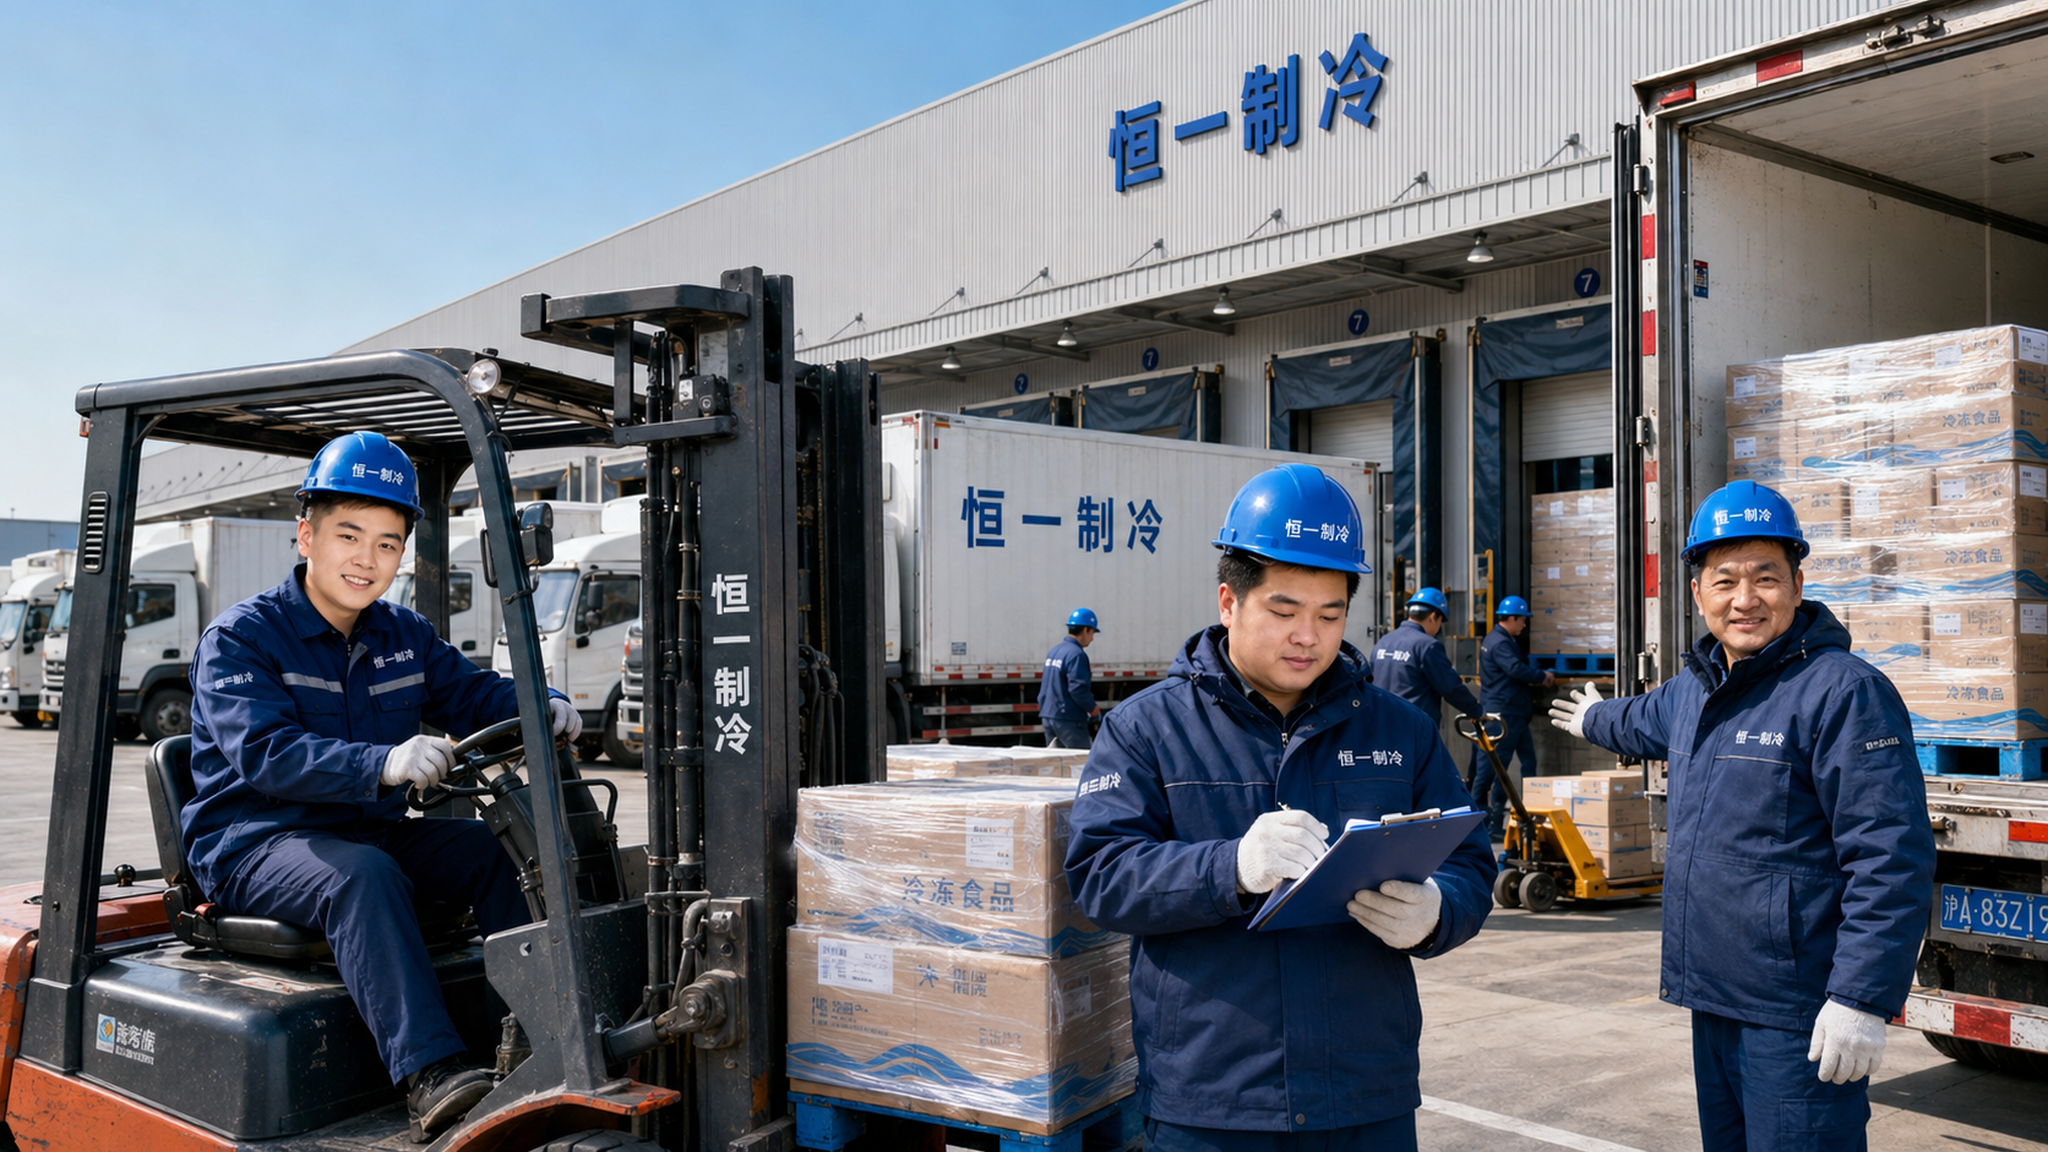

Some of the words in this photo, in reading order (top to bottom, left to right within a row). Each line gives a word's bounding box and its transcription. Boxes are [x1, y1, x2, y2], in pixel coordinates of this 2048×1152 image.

[1108, 32, 1389, 193] 恒一制冷
[1581, 273, 1593, 292] 7
[1353, 314, 1363, 331] 7
[352, 463, 404, 486] 恒一制冷
[961, 486, 1163, 555] 恒一制冷
[1714, 508, 1772, 526] 恒一制冷
[1285, 518, 1350, 543] 恒一制冷
[711, 573, 752, 755] 恒一制冷
[1338, 749, 1403, 767] 恒一制冷
[902, 875, 1014, 913] 冷冻食品
